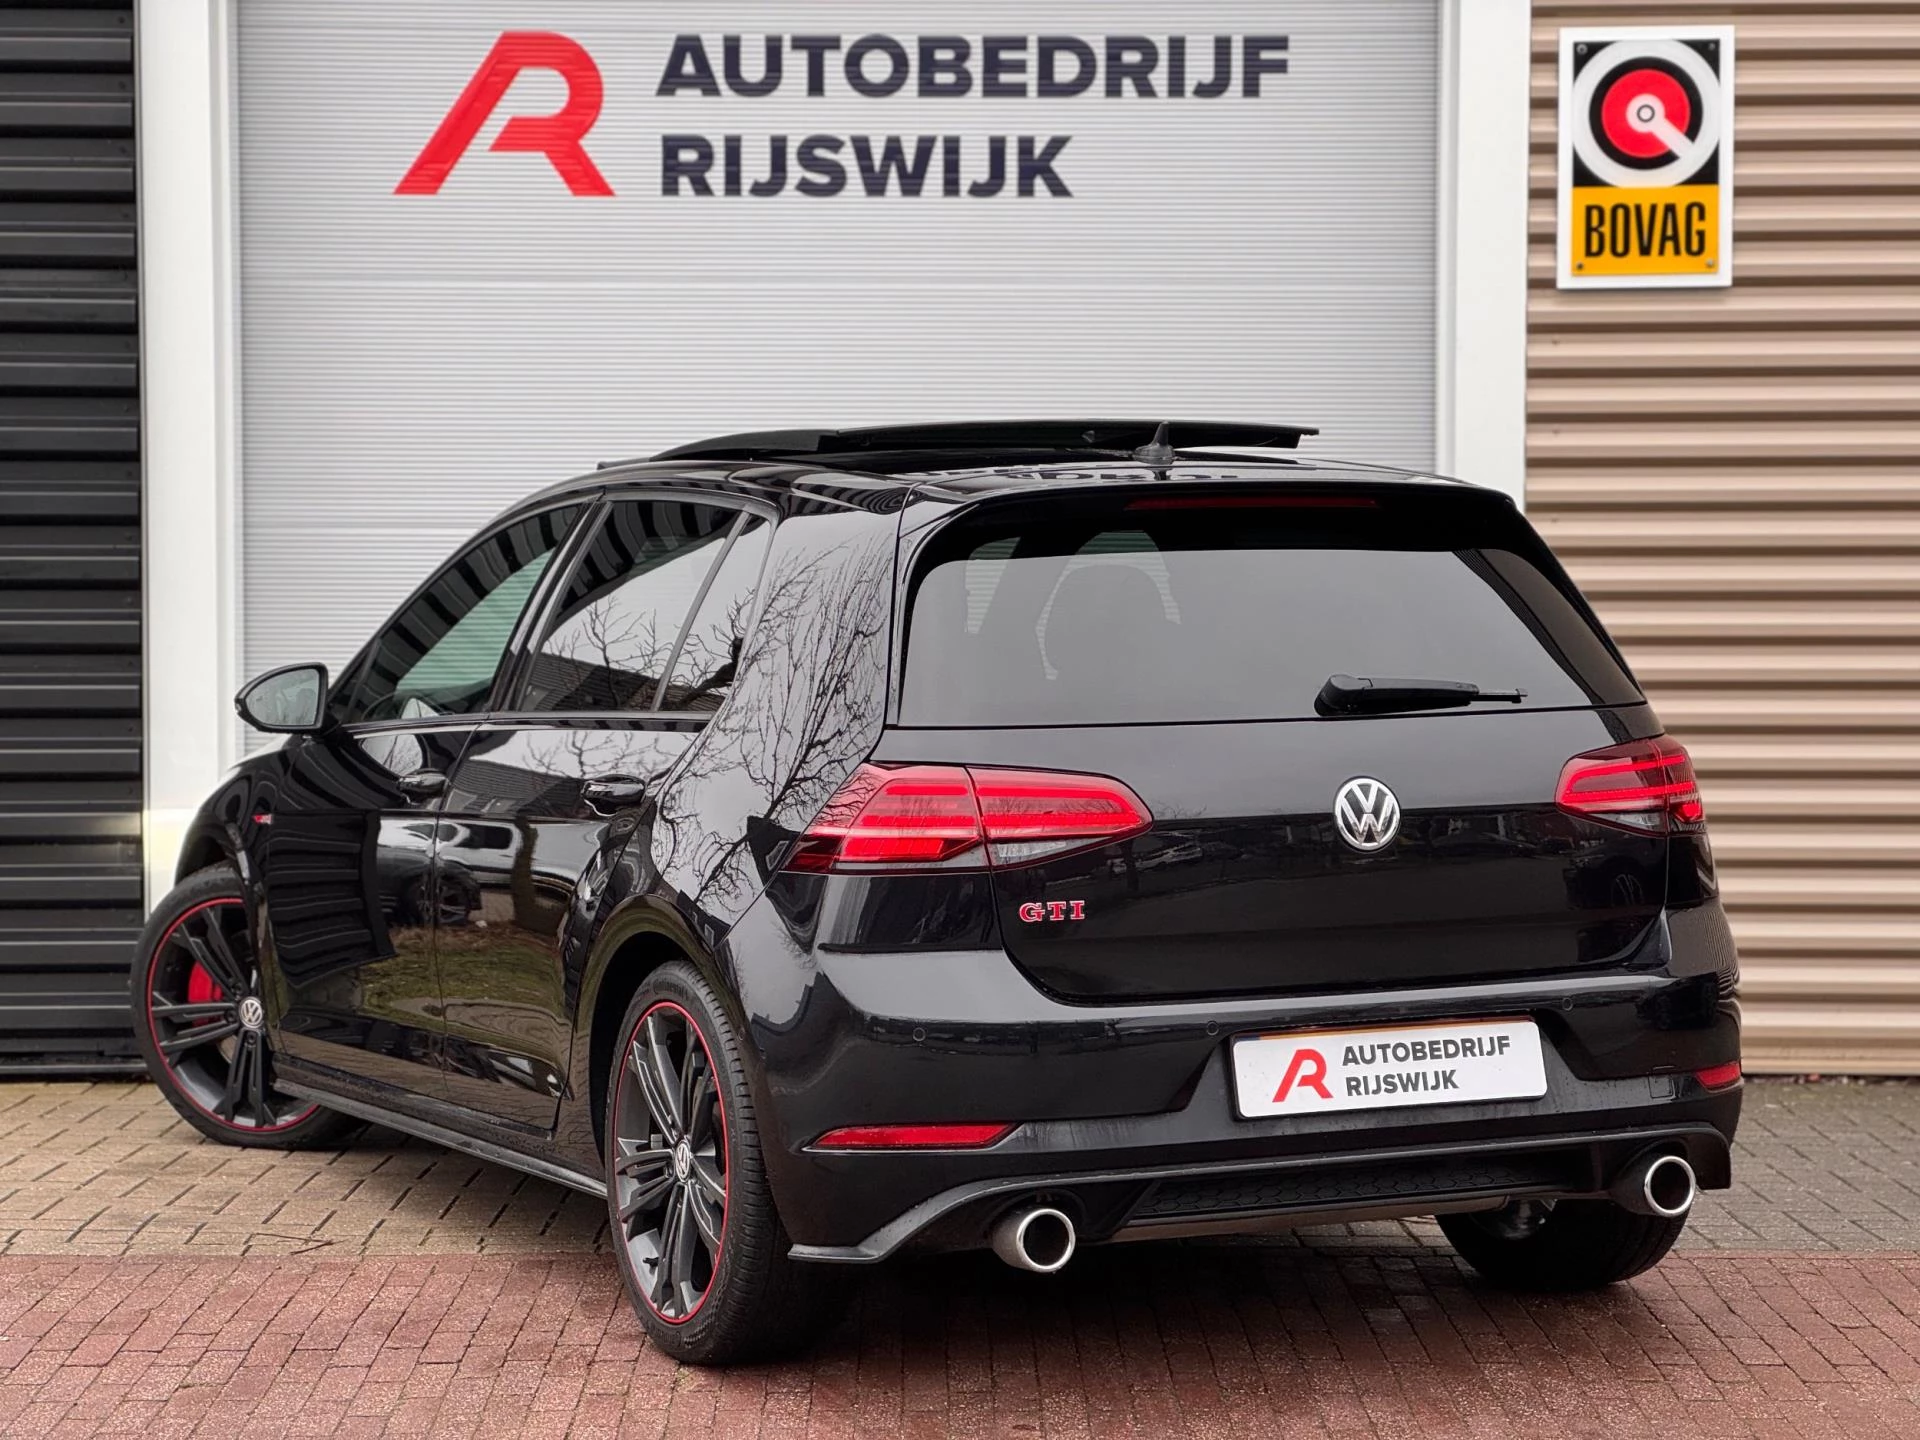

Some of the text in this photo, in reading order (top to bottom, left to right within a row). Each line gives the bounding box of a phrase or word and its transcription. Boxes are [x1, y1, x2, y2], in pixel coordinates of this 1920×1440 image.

[657, 36, 1288, 98] AUTOBEDRIJF
[663, 136, 1070, 197] RIJSWIJK
[1585, 202, 1706, 258] BOVAG
[1019, 900, 1085, 922] GTI
[1342, 1035, 1512, 1066] AUTOBEDRIJF
[1345, 1069, 1460, 1097] RIJSWIJK
